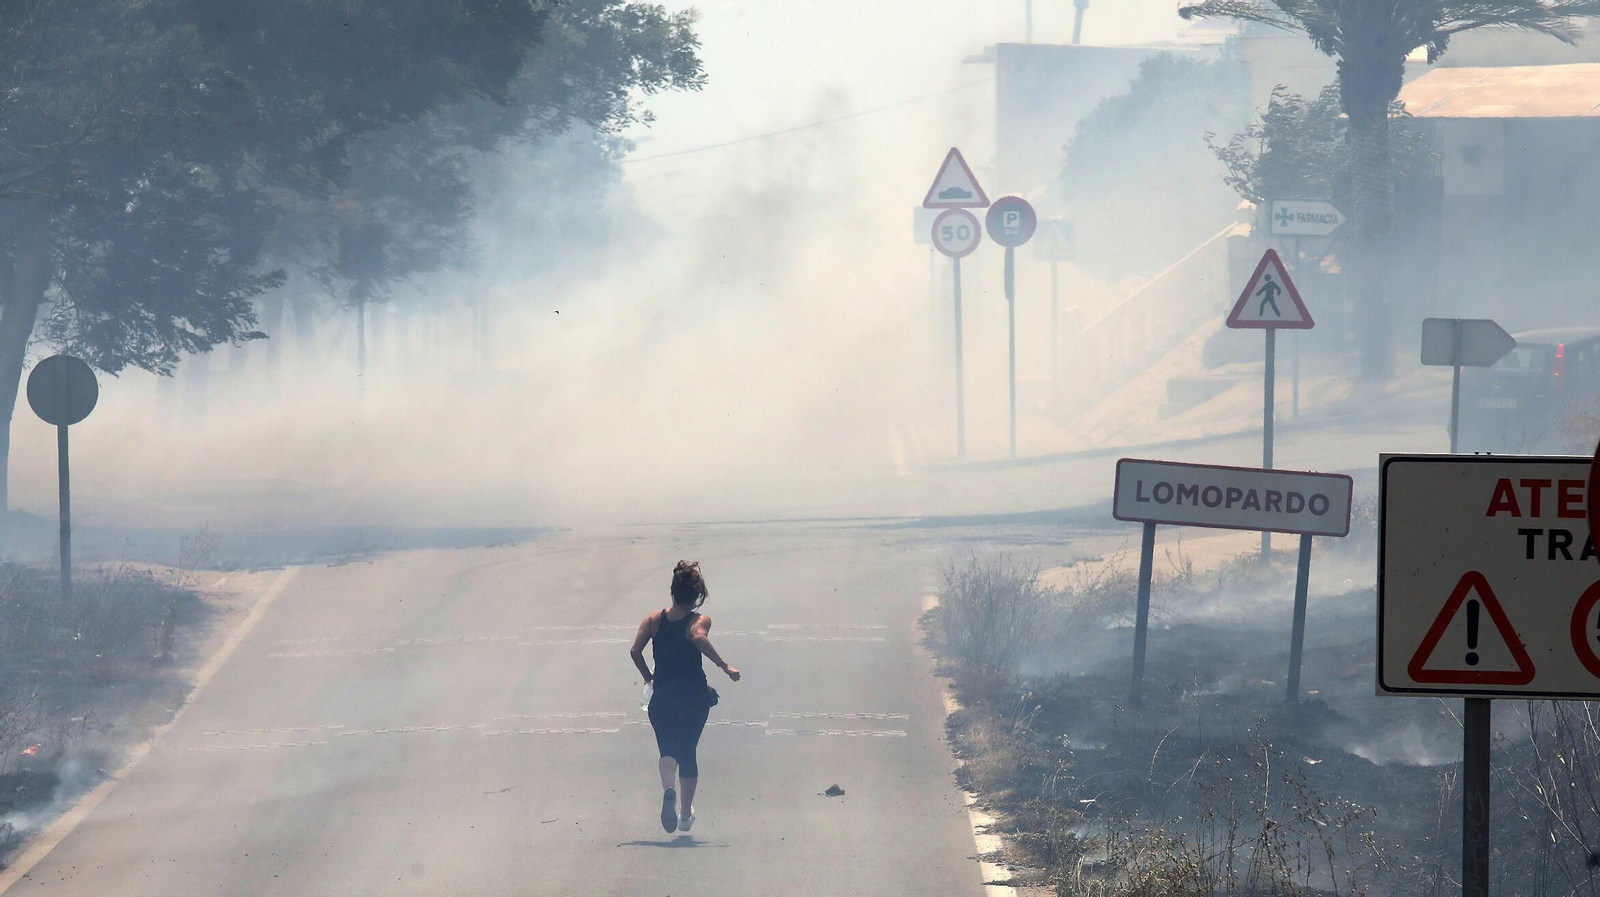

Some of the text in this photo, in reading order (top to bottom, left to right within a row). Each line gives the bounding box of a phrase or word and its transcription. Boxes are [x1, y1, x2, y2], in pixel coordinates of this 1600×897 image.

[1296, 213, 1339, 224] FARMACIA
[941, 224, 971, 242] 50
[1135, 479, 1330, 516] LOMOPARDO
